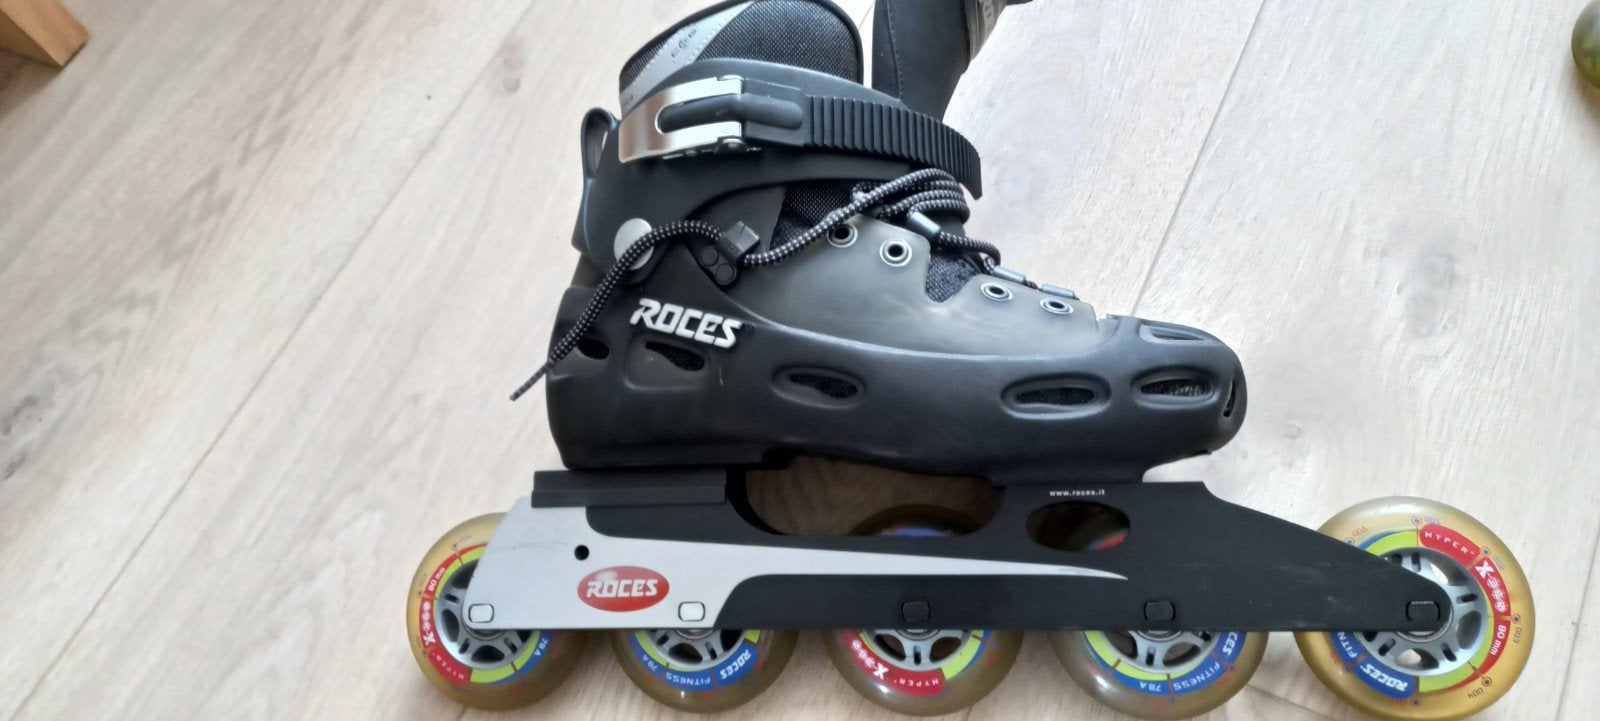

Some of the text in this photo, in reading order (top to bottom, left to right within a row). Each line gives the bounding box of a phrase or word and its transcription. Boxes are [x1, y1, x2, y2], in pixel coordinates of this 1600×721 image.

[629, 297, 742, 349] ROCES
[1048, 489, 1106, 497] www.roces.it
[1424, 530, 1469, 554] HYPER
[586, 579, 658, 598] ROCES
[1223, 632, 1238, 656] CES
[1490, 624, 1507, 656] 80 mm
[720, 649, 750, 679] ROCES
[1173, 661, 1221, 691] FITNESS
[665, 672, 711, 686] FITNESS
[899, 677, 939, 687] HYPER
[1362, 664, 1408, 691] ROCES
